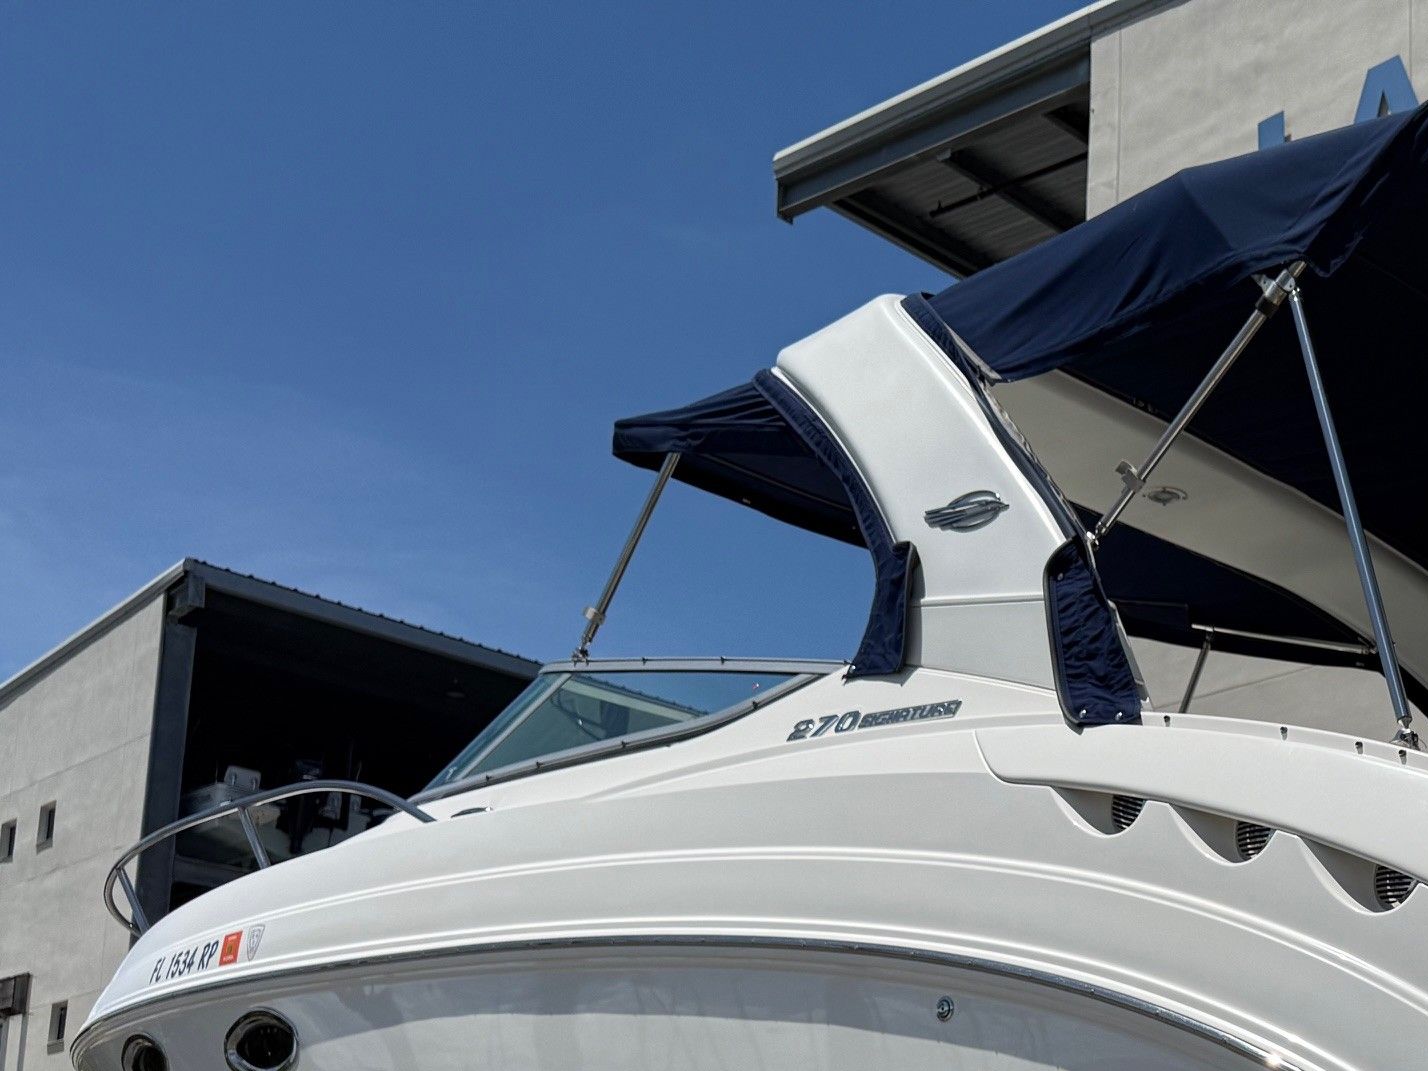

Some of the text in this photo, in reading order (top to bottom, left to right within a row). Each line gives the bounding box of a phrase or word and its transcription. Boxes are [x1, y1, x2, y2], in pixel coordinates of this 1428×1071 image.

[858, 699, 963, 729] SIGNATURE
[149, 940, 219, 986] FL 1534 RP
